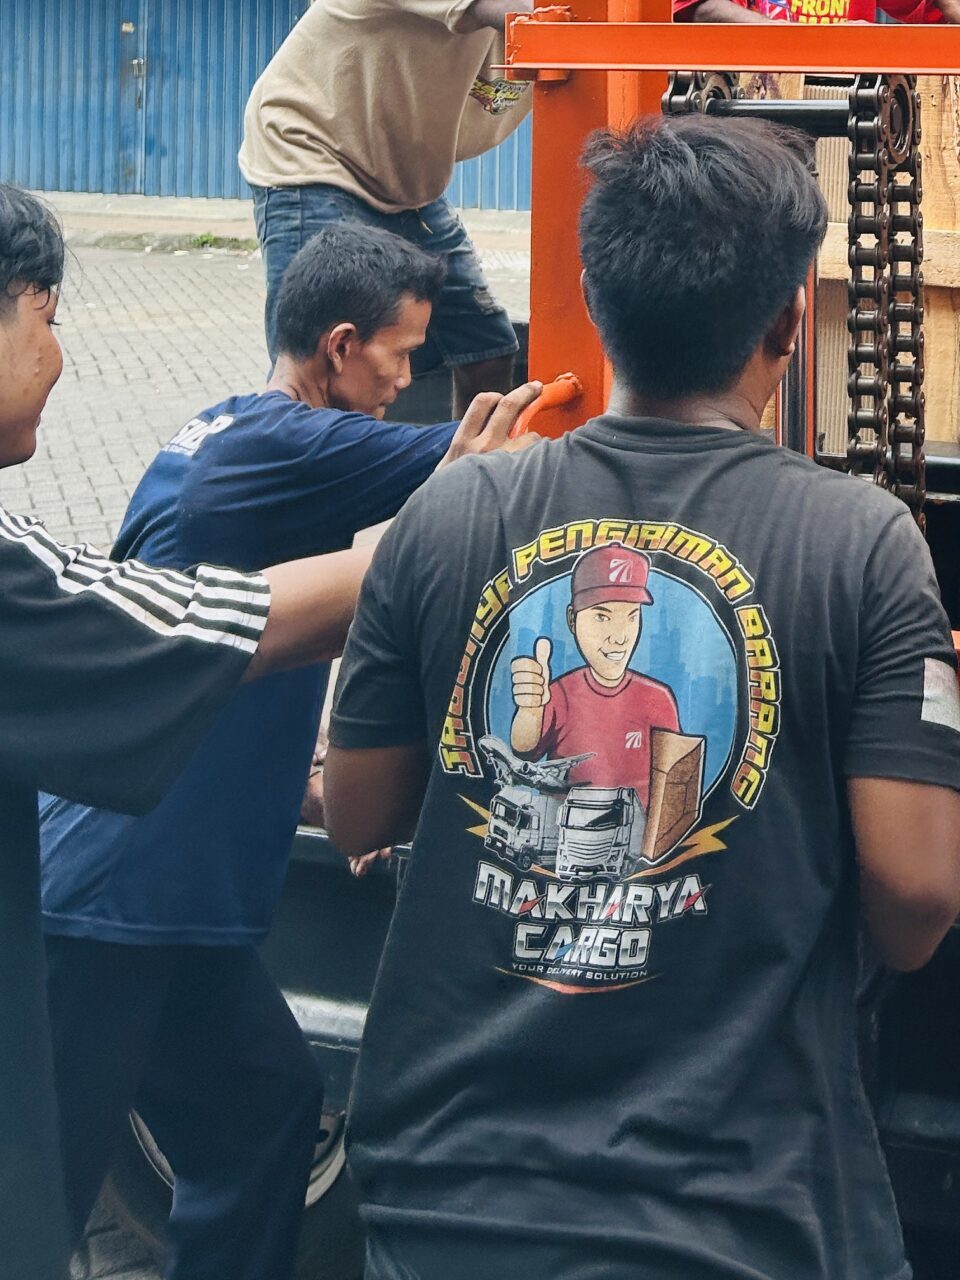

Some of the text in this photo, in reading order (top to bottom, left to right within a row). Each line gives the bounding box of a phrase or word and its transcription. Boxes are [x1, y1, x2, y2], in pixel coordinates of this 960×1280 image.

[514, 520, 754, 600] PENGIRIMAN
[733, 604, 782, 809] BARANG
[472, 860, 710, 926] MAKHARYA
[512, 963, 544, 974] YOUR
[585, 969, 648, 981] SOLUTION
[513, 922, 652, 970] CARGO
